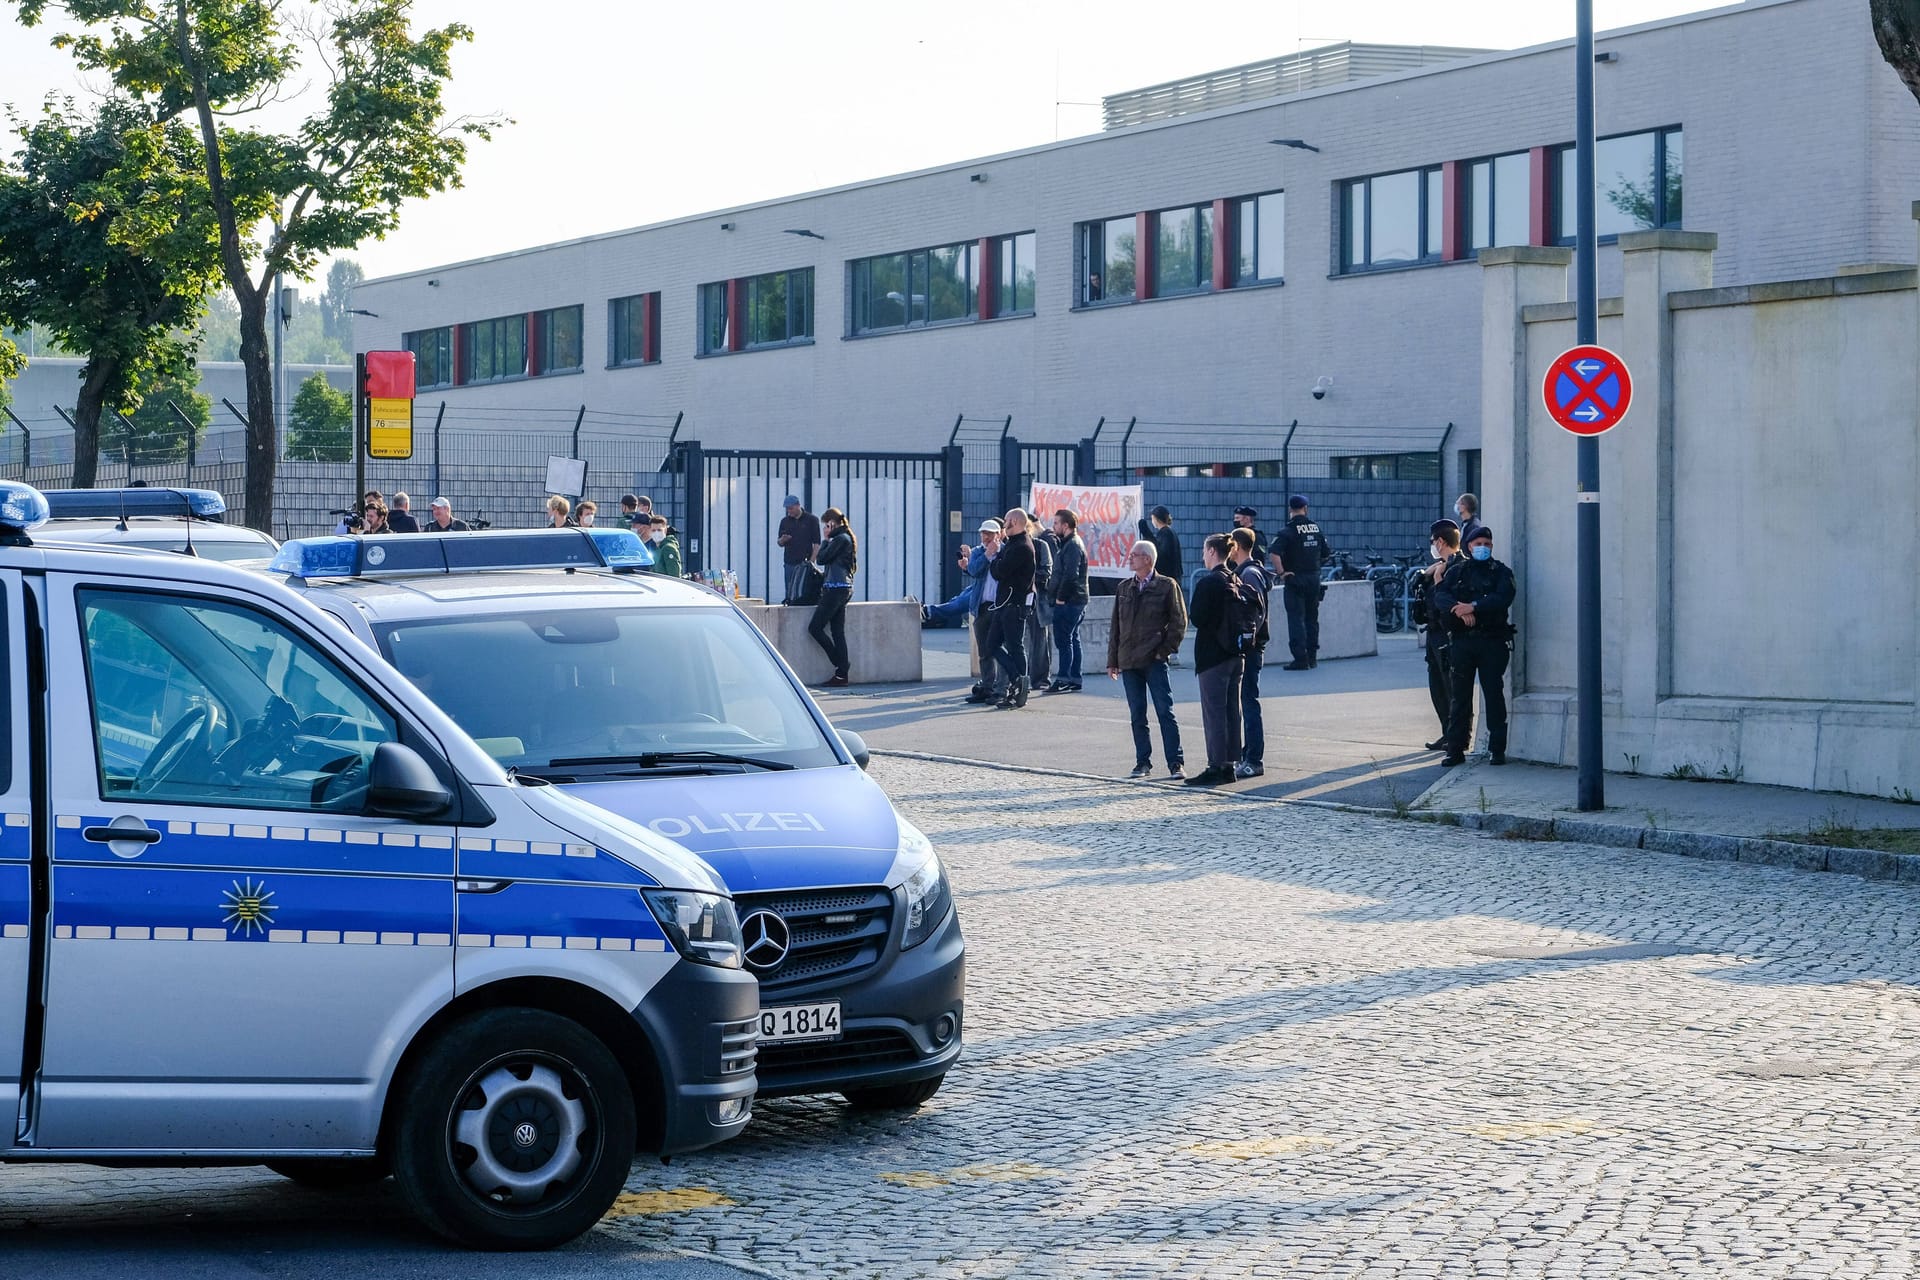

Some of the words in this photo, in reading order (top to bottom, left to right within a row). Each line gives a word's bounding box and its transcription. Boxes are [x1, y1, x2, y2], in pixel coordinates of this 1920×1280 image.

[647, 812, 827, 838] OLIZEI
[761, 1012, 776, 1037] Q
[782, 1006, 838, 1036] 1814
